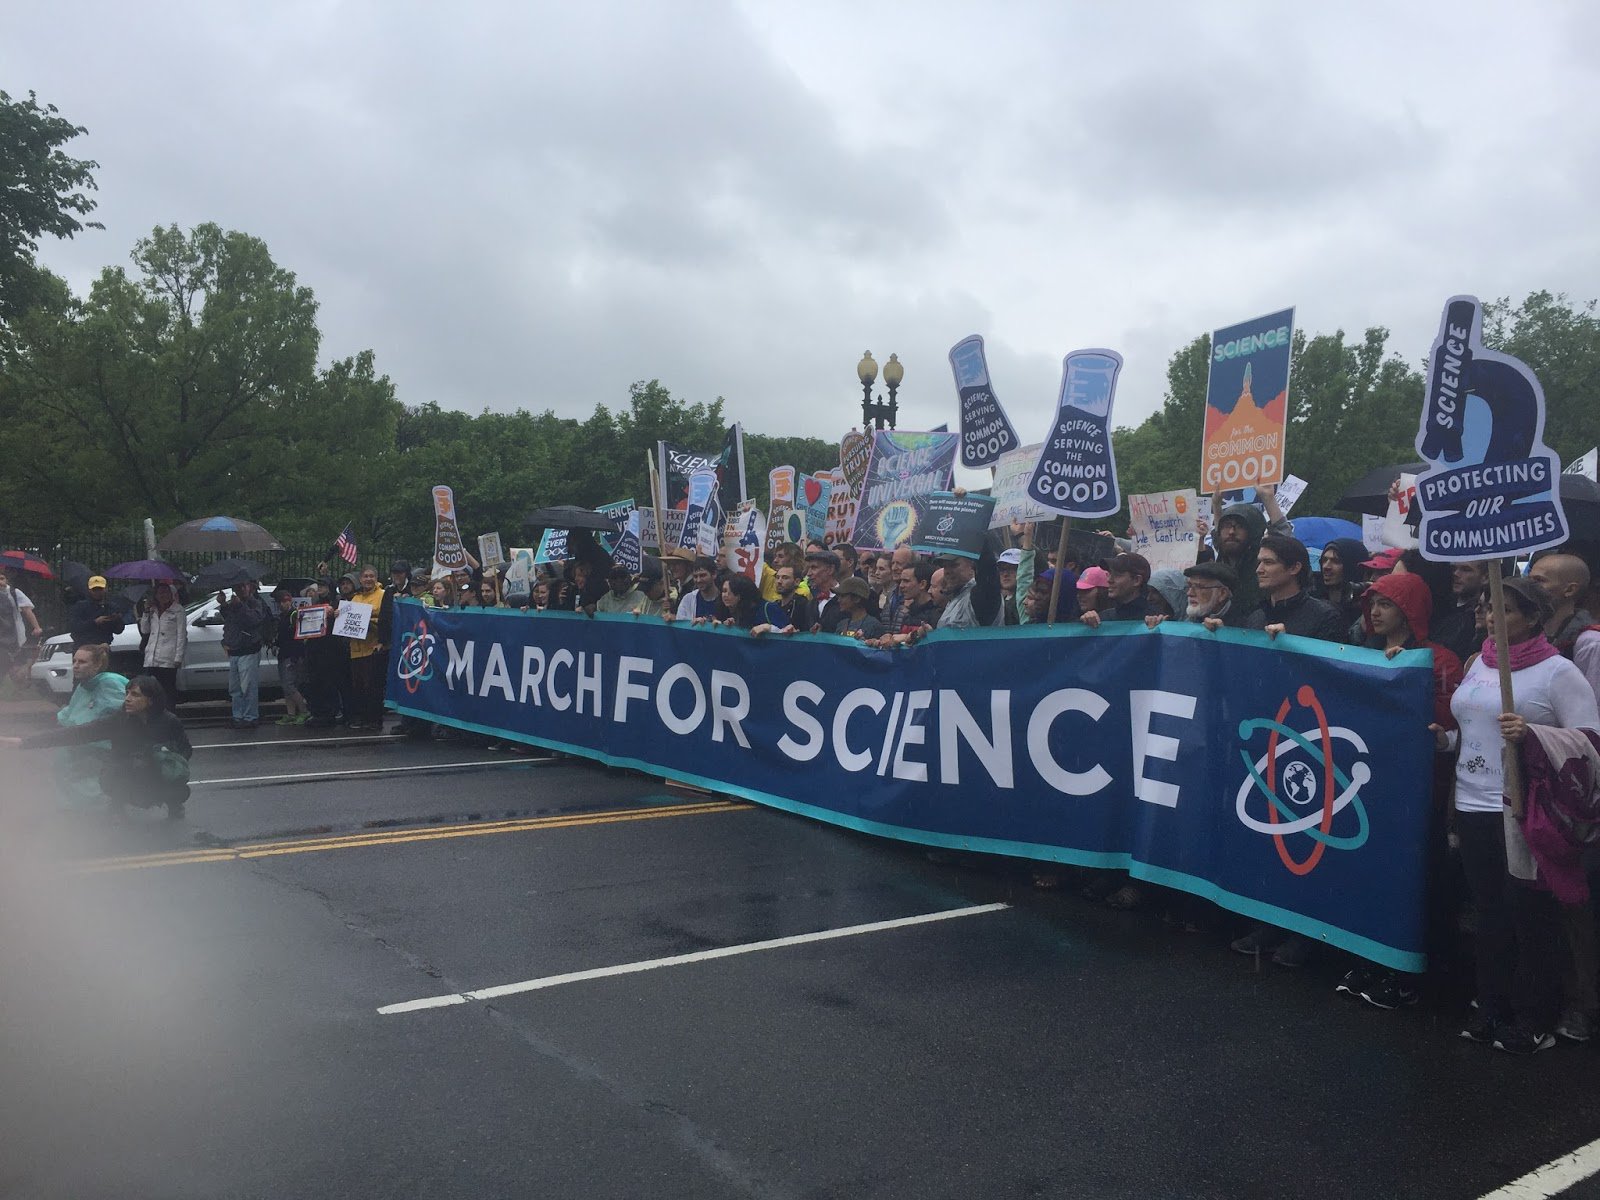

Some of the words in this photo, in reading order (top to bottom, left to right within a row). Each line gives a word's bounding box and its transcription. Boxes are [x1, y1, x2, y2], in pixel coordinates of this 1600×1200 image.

[1213, 326, 1289, 363] SCIENCE
[1436, 322, 1467, 429] SCIENCE
[964, 392, 990, 410] SCIENCE
[965, 404, 995, 423] SERVING
[975, 417, 985, 427] THE
[965, 417, 1003, 443] COMMON
[1060, 420, 1102, 437] SCIENCE
[1231, 428, 1242, 440] for
[1243, 425, 1255, 434] the
[965, 430, 1009, 460] GOOD
[1054, 438, 1103, 454] SERVING
[1208, 432, 1278, 460] COMMON
[845, 446, 872, 475] TRUTH
[1066, 452, 1082, 461] THE
[1044, 460, 1106, 478] COMMON
[1206, 455, 1277, 486] GOOD
[1037, 475, 1108, 503] GOOD
[1426, 462, 1546, 501] PROTECTING
[1130, 494, 1168, 517] Without
[1465, 495, 1505, 519] OUR
[836, 519, 846, 528] TO
[1148, 515, 1183, 530] Research
[1430, 512, 1556, 549] COMMUNITIES
[1135, 530, 1149, 543] We
[1175, 528, 1194, 542] Cure
[439, 543, 460, 551] COMMON
[616, 550, 639, 562] COMMON
[438, 551, 462, 563] GOOD
[446, 638, 602, 718] MARCH
[613, 655, 752, 749] FOR
[776, 680, 1197, 808] SCIENCE
